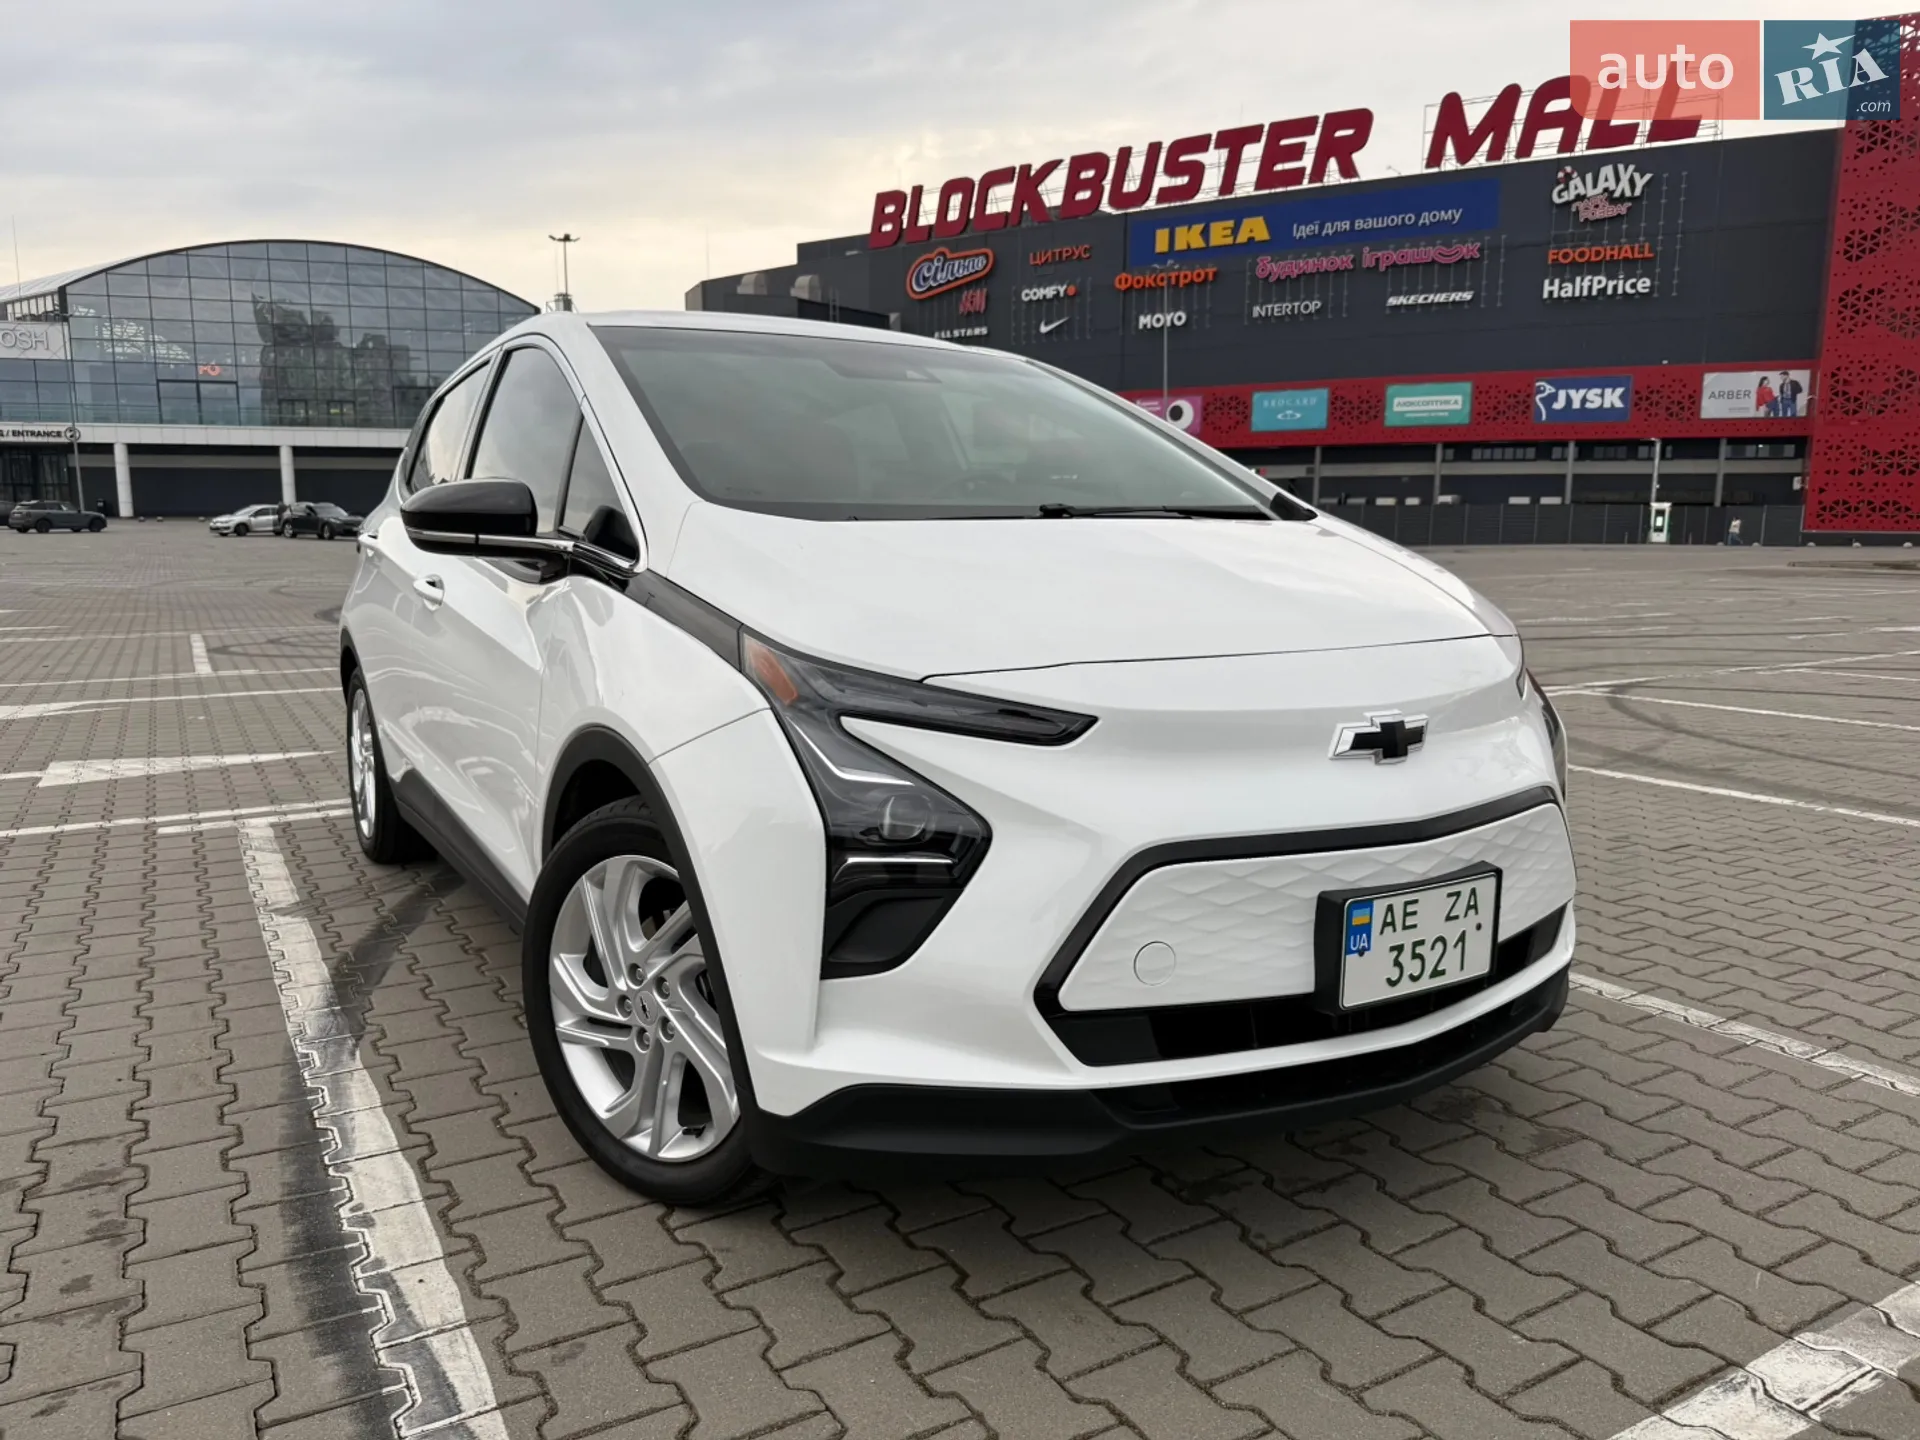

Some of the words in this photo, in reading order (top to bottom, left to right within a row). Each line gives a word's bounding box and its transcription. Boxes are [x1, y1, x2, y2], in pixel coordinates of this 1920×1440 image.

[868, 107, 1374, 249] BLOCKBUSTER
[1425, 60, 1703, 168] MALL
[1552, 163, 1654, 204] GALAXY
[1155, 216, 1271, 253] IKEA
[1293, 220, 1319, 239] Ідеї
[1322, 220, 1350, 236] для
[1354, 213, 1415, 231] вашого
[1418, 208, 1463, 226] дому
[1029, 244, 1091, 266] ЦИТРУС
[1548, 242, 1654, 264] FOODHALL
[1256, 254, 1353, 282] будинок
[1114, 268, 1218, 291] Фокстрот
[1542, 275, 1652, 299] HalfPrice
[1021, 284, 1068, 302] COMFY
[1386, 291, 1475, 307] SKECHERS
[1138, 310, 1187, 329] MOYO
[1252, 300, 1322, 318] INTERTOP
[1552, 387, 1625, 409] JYSK
[1708, 389, 1752, 400] ARBER
[12, 429, 62, 439] ENTRANCE
[1379, 899, 1419, 935] AE
[1444, 887, 1479, 922] ZA
[1350, 933, 1368, 950] UA
[1385, 930, 1466, 987] 3521
